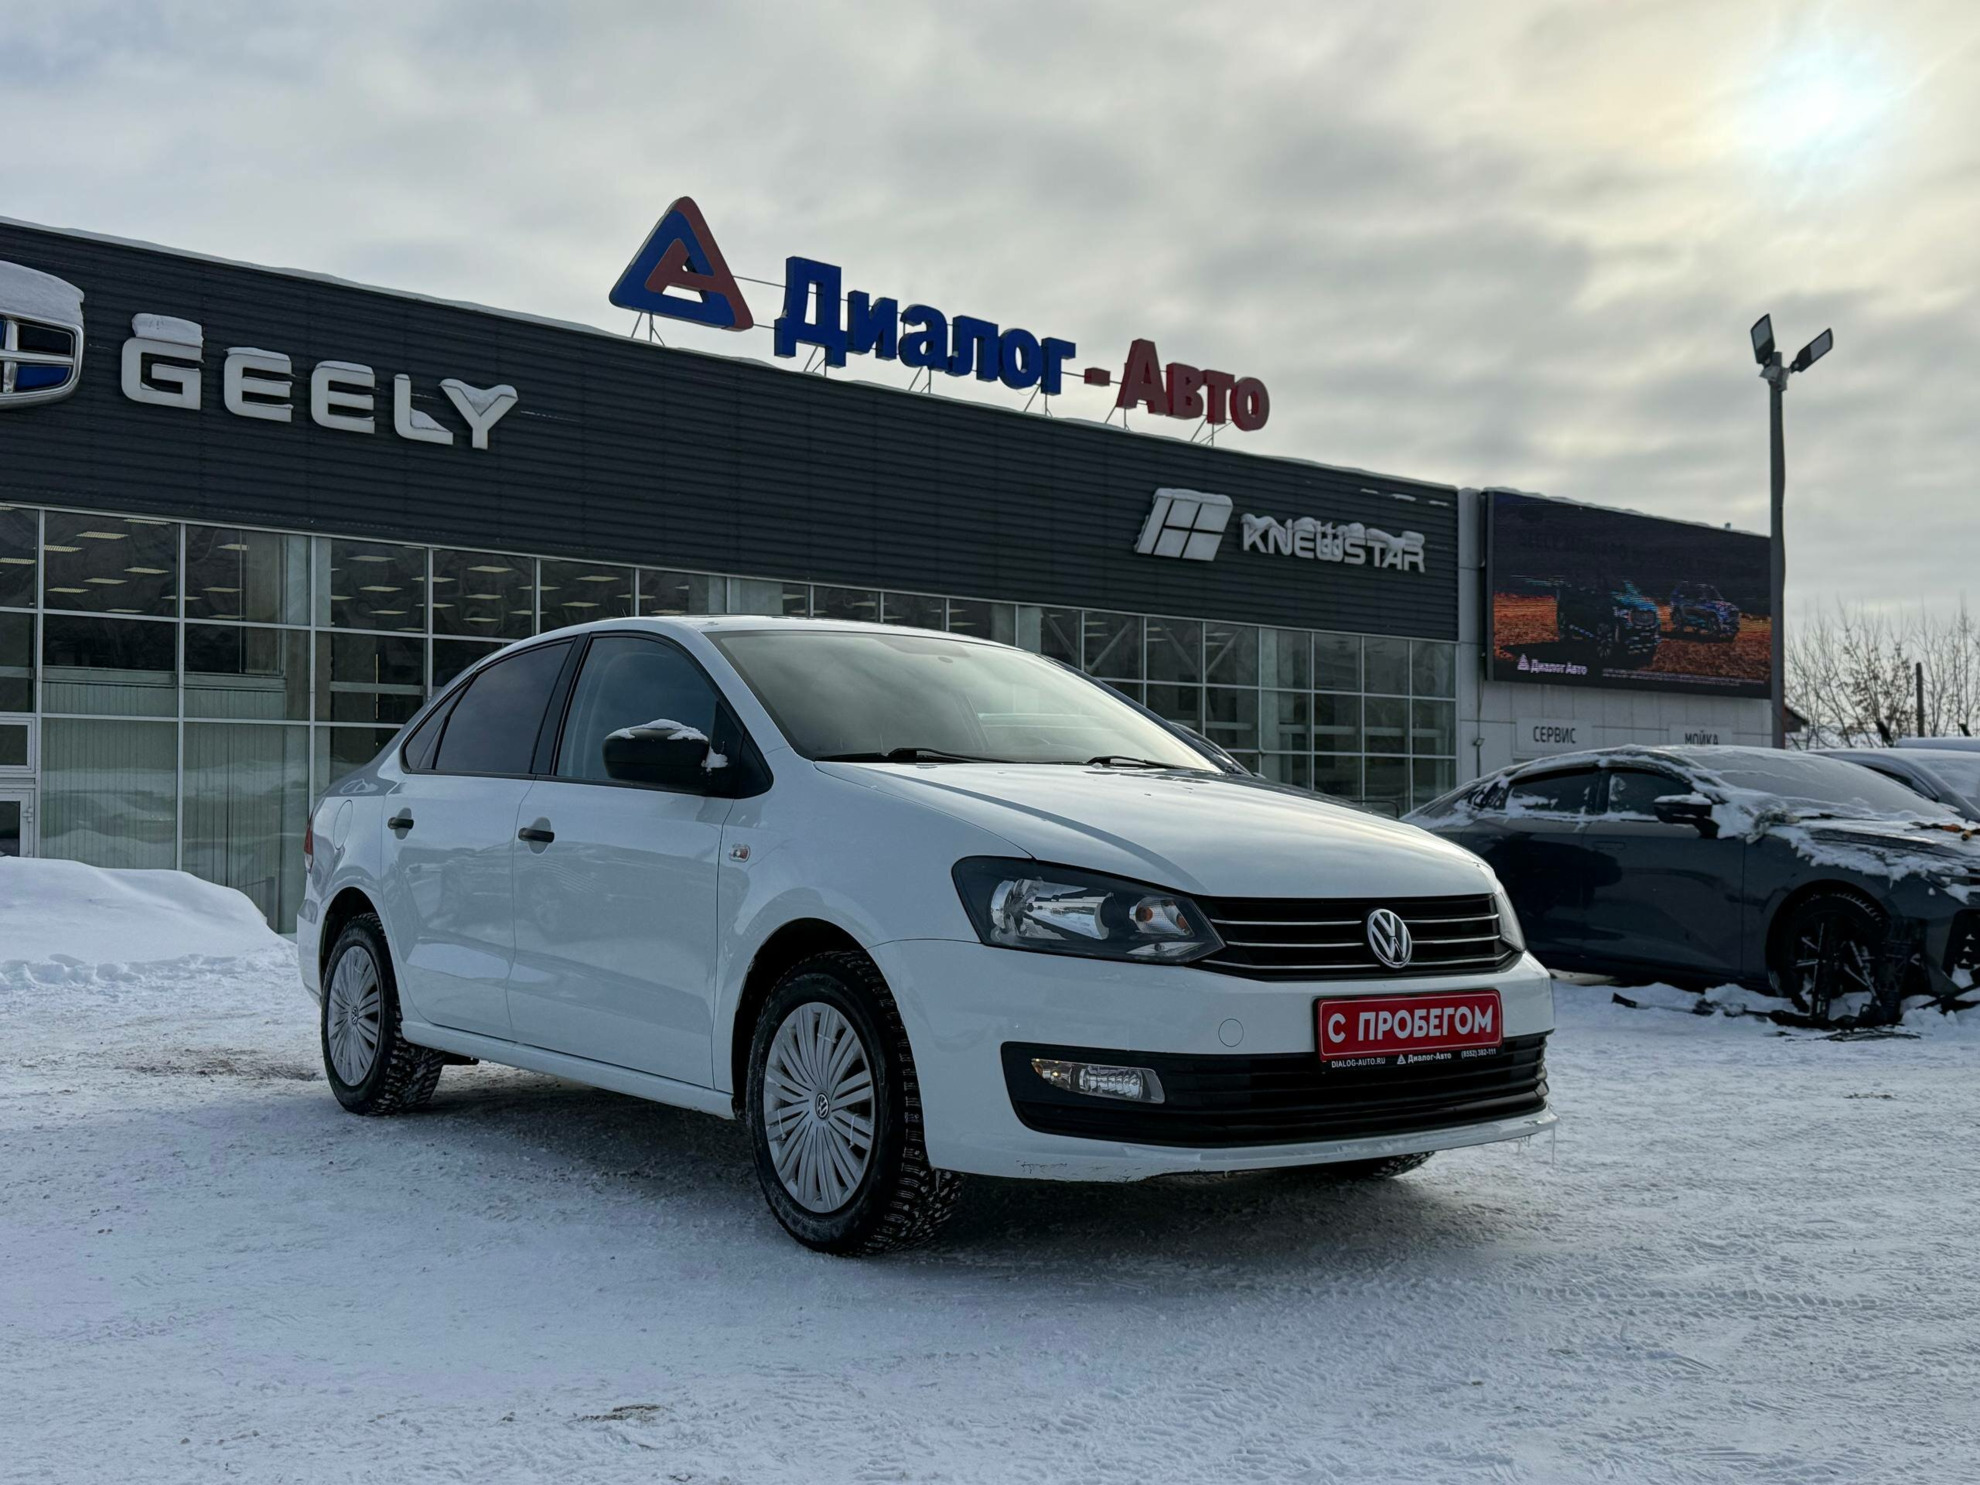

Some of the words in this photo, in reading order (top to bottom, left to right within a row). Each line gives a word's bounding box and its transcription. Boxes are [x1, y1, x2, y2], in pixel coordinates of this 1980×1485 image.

[121, 335, 518, 450] GEELY
[1242, 516, 1425, 573] KNEWSTAR
[1533, 725, 1577, 744] СЕРВИС
[1684, 730, 1719, 745] МОЙКА
[1328, 1013, 1346, 1043] С
[1358, 1005, 1494, 1041] ПРОБЕГОМ
[1331, 1057, 1386, 1068] DIALOG-AUTO.RU
